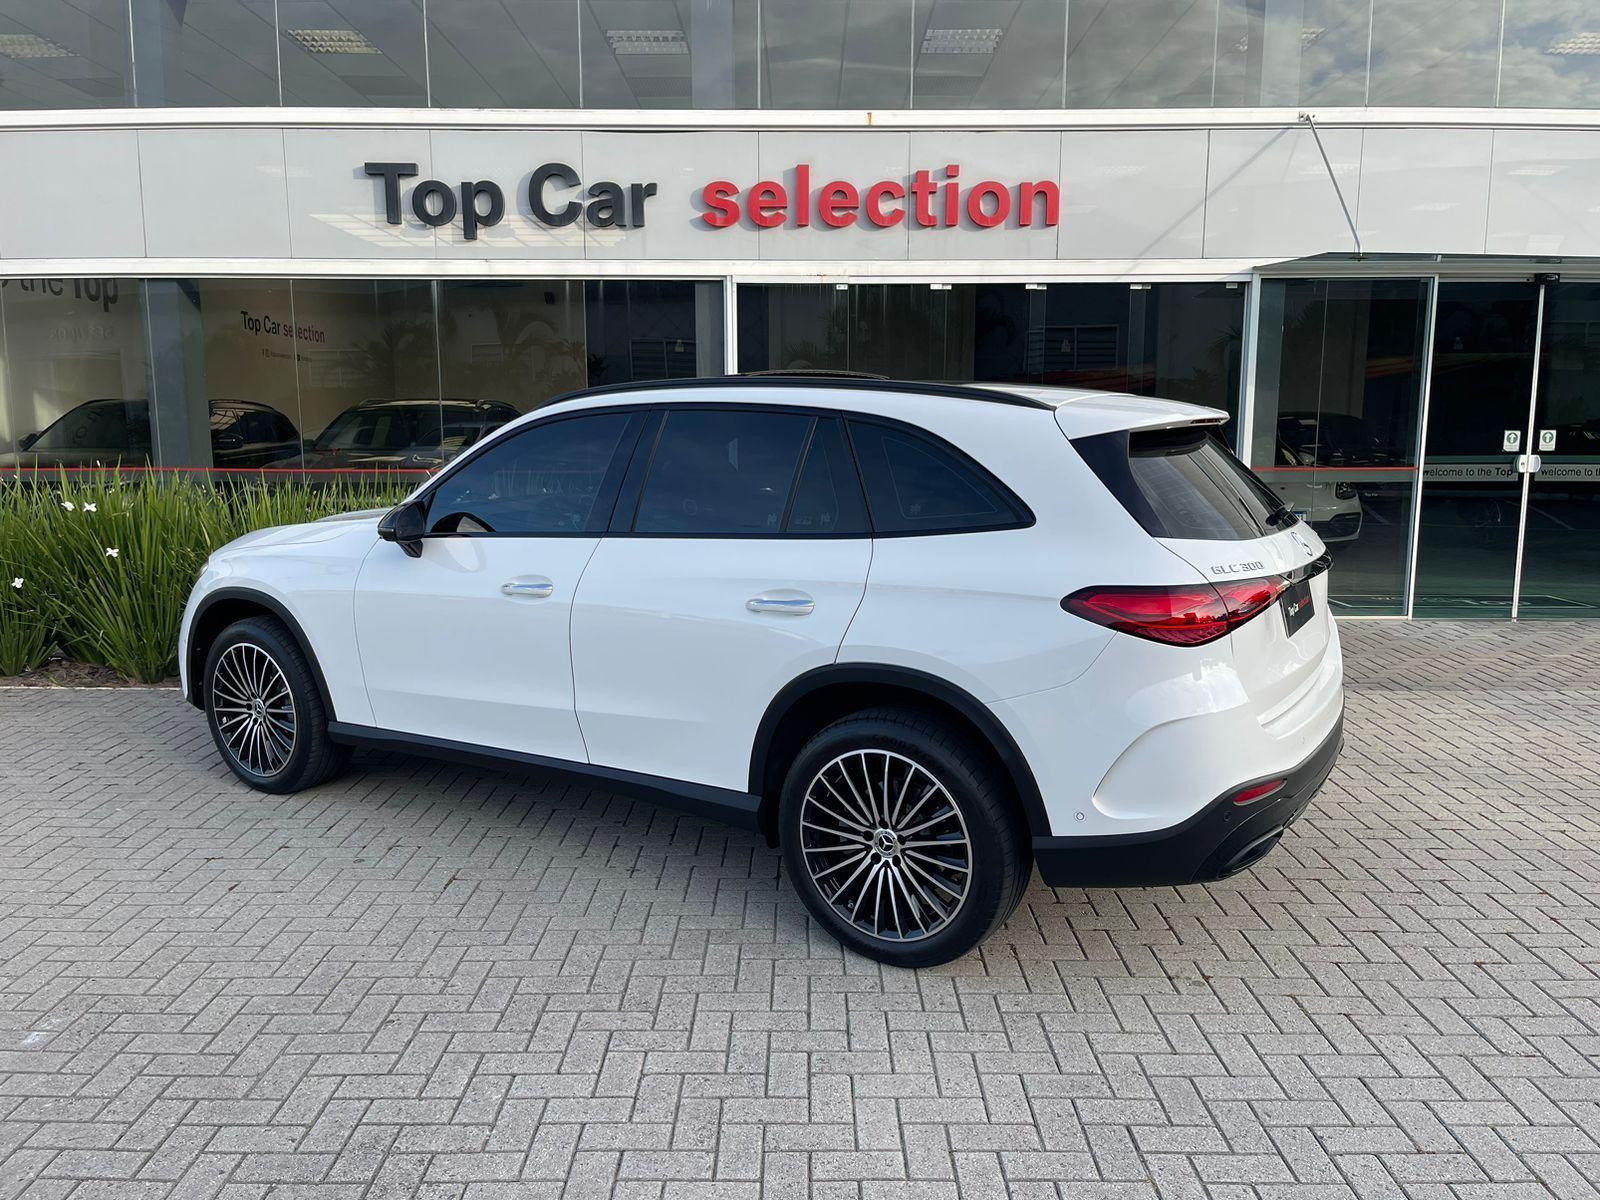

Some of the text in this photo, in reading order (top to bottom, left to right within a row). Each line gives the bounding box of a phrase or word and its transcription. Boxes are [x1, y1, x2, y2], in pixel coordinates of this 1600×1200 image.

[364, 162, 1061, 240] Top Car selection
[240, 310, 325, 343] Top Car selection
[1422, 467, 1513, 478] welcome to the Top
[1541, 467, 1582, 476] welcome
[1584, 467, 1593, 476] to
[1211, 561, 1265, 575] GLC 300
